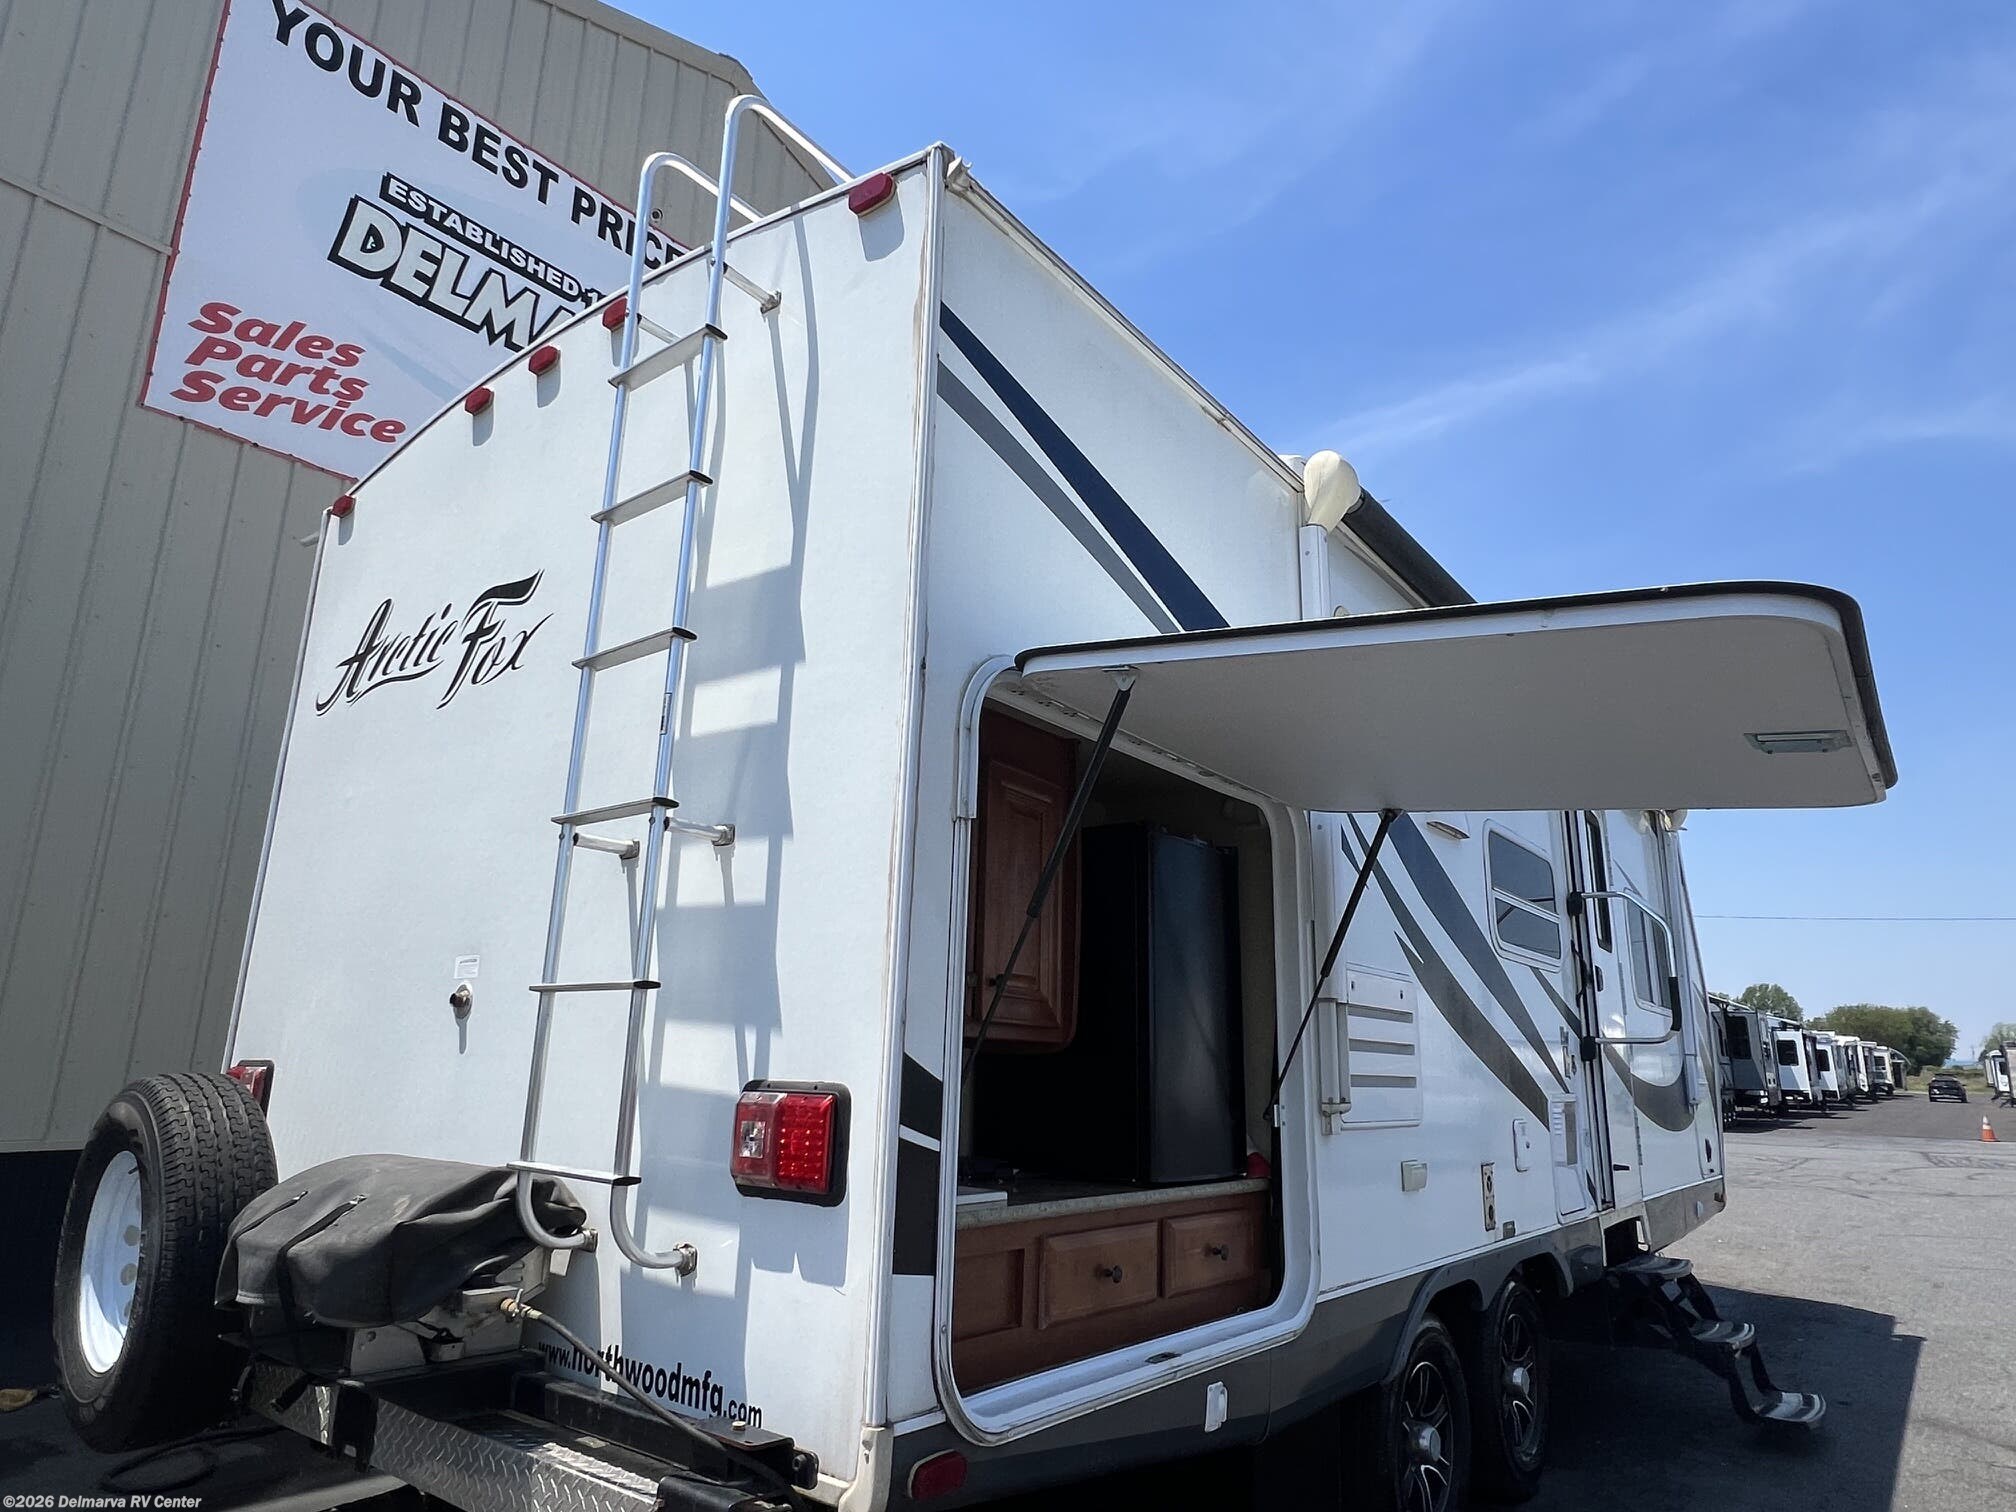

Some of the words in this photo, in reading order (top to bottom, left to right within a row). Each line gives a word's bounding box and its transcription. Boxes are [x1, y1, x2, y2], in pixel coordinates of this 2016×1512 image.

[272, 0, 422, 127] YOUR
[437, 100, 559, 206] BEST
[384, 175, 582, 299] ESTABLISHED
[184, 336, 370, 402] Parts
[188, 302, 366, 367] Sales
[170, 371, 406, 442] Service
[316, 598, 458, 716] Arctic
[436, 569, 554, 709] Fox
